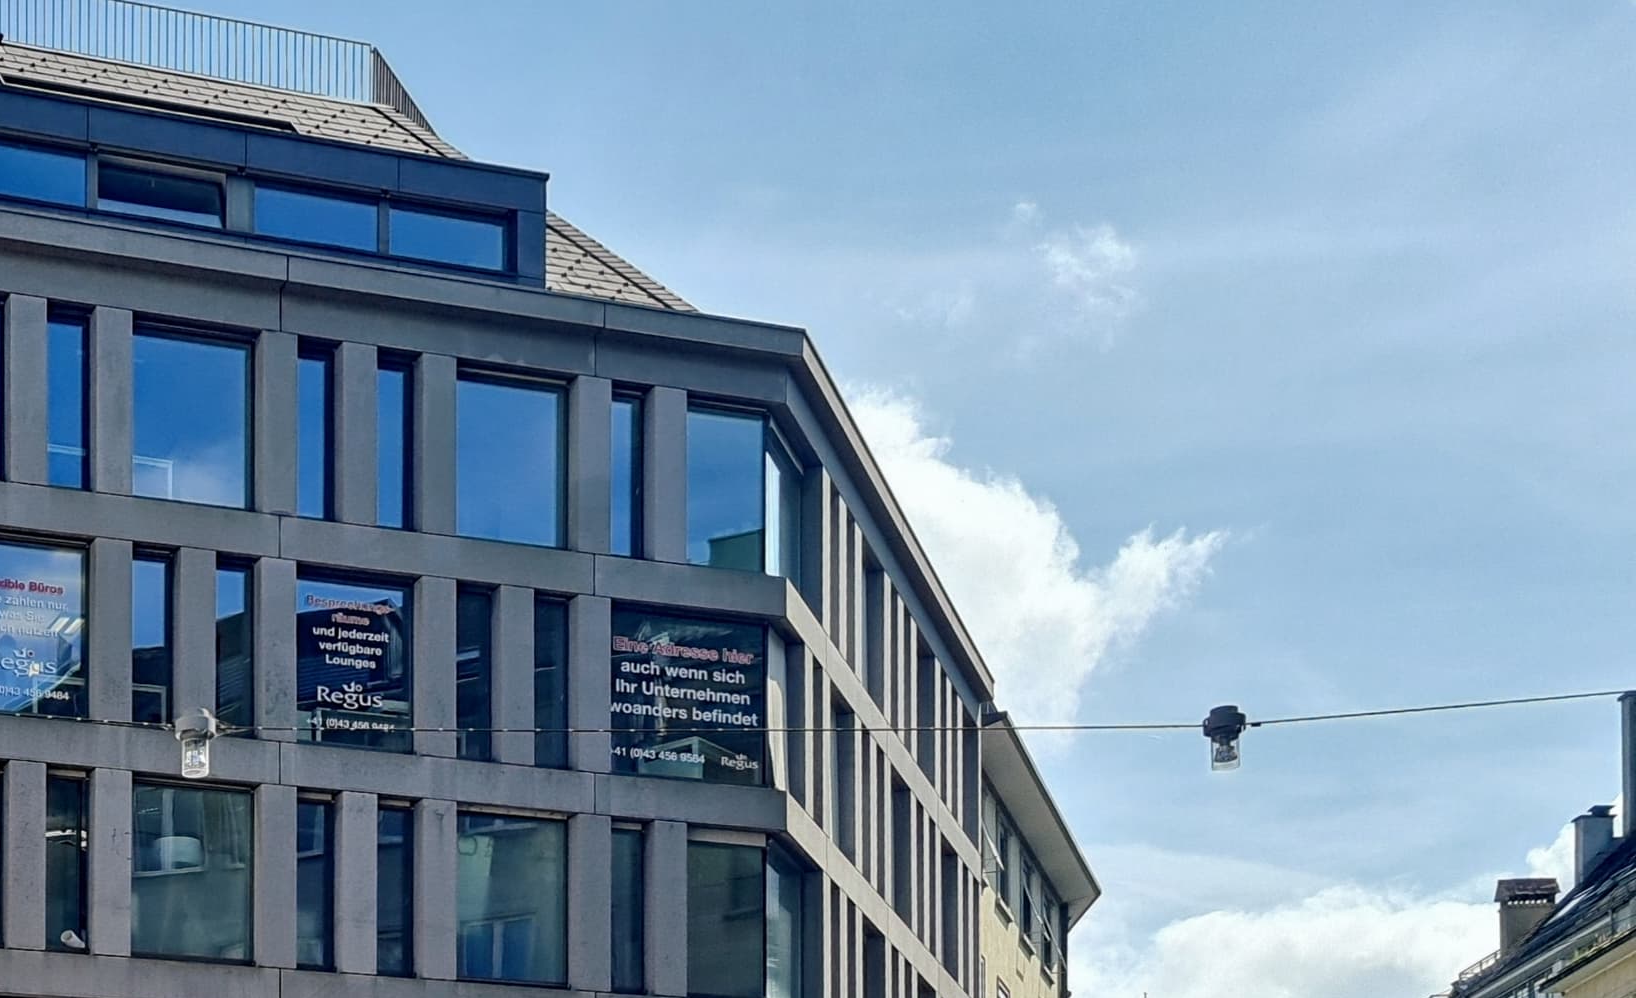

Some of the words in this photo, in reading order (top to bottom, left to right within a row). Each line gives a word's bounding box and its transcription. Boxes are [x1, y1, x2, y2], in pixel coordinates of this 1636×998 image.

[28, 580, 64, 595] Büros
[312, 626, 336, 638] und
[337, 628, 390, 644] jederzeit
[318, 641, 383, 657] verfügbare
[613, 635, 649, 654] Eine
[652, 641, 720, 662] Adresse
[325, 653, 377, 670] Lounges
[620, 660, 660, 676] auch
[664, 666, 708, 681] wenn
[712, 669, 746, 685] sich
[316, 685, 384, 710] Regus
[615, 678, 638, 693] Ihr
[641, 681, 752, 705] Unternehmen
[610, 701, 688, 720] woanders
[692, 706, 759, 727] befindet
[720, 754, 759, 770] Regus
